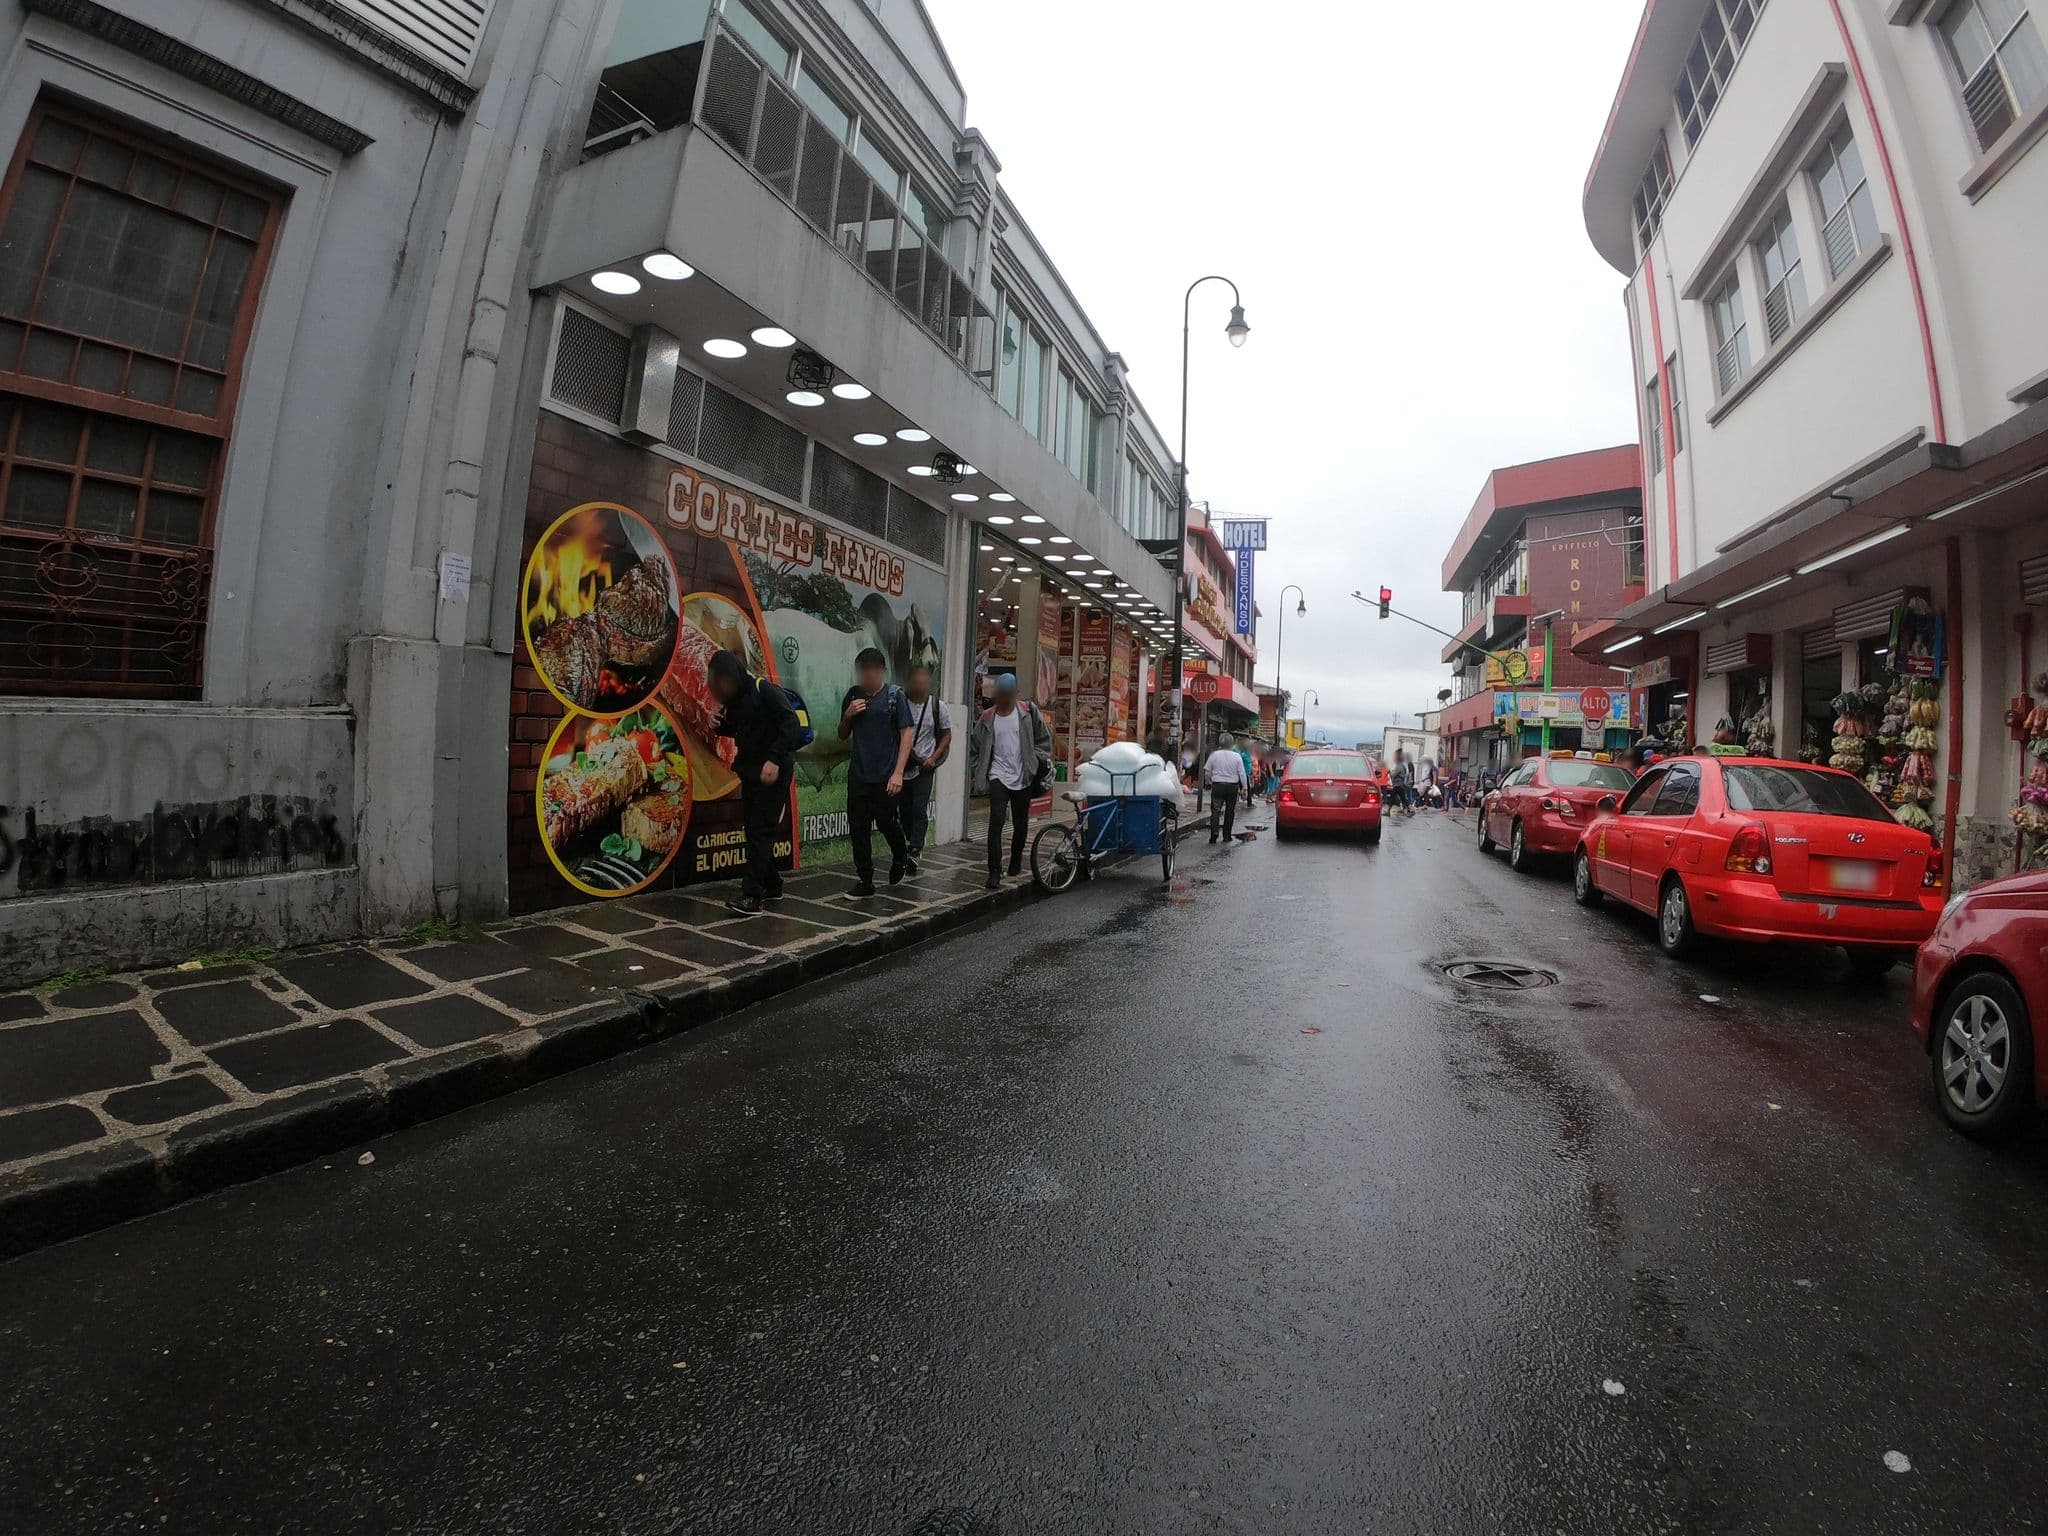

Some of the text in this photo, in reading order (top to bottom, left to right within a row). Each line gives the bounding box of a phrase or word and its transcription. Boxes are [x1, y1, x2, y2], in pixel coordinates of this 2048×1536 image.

[665, 469, 905, 597] CORTES FINOS
[1223, 522, 1266, 549] HOTEL
[1552, 541, 1600, 552] EDIFICIO
[1238, 560, 1250, 629] DESCANSO
[1569, 558, 1581, 635] ROMA
[1192, 680, 1217, 694] ALTO
[1581, 695, 1609, 710] ALTO
[696, 825, 747, 849] CARNICERÍ
[696, 840, 792, 873] EL NOVILL ORO
